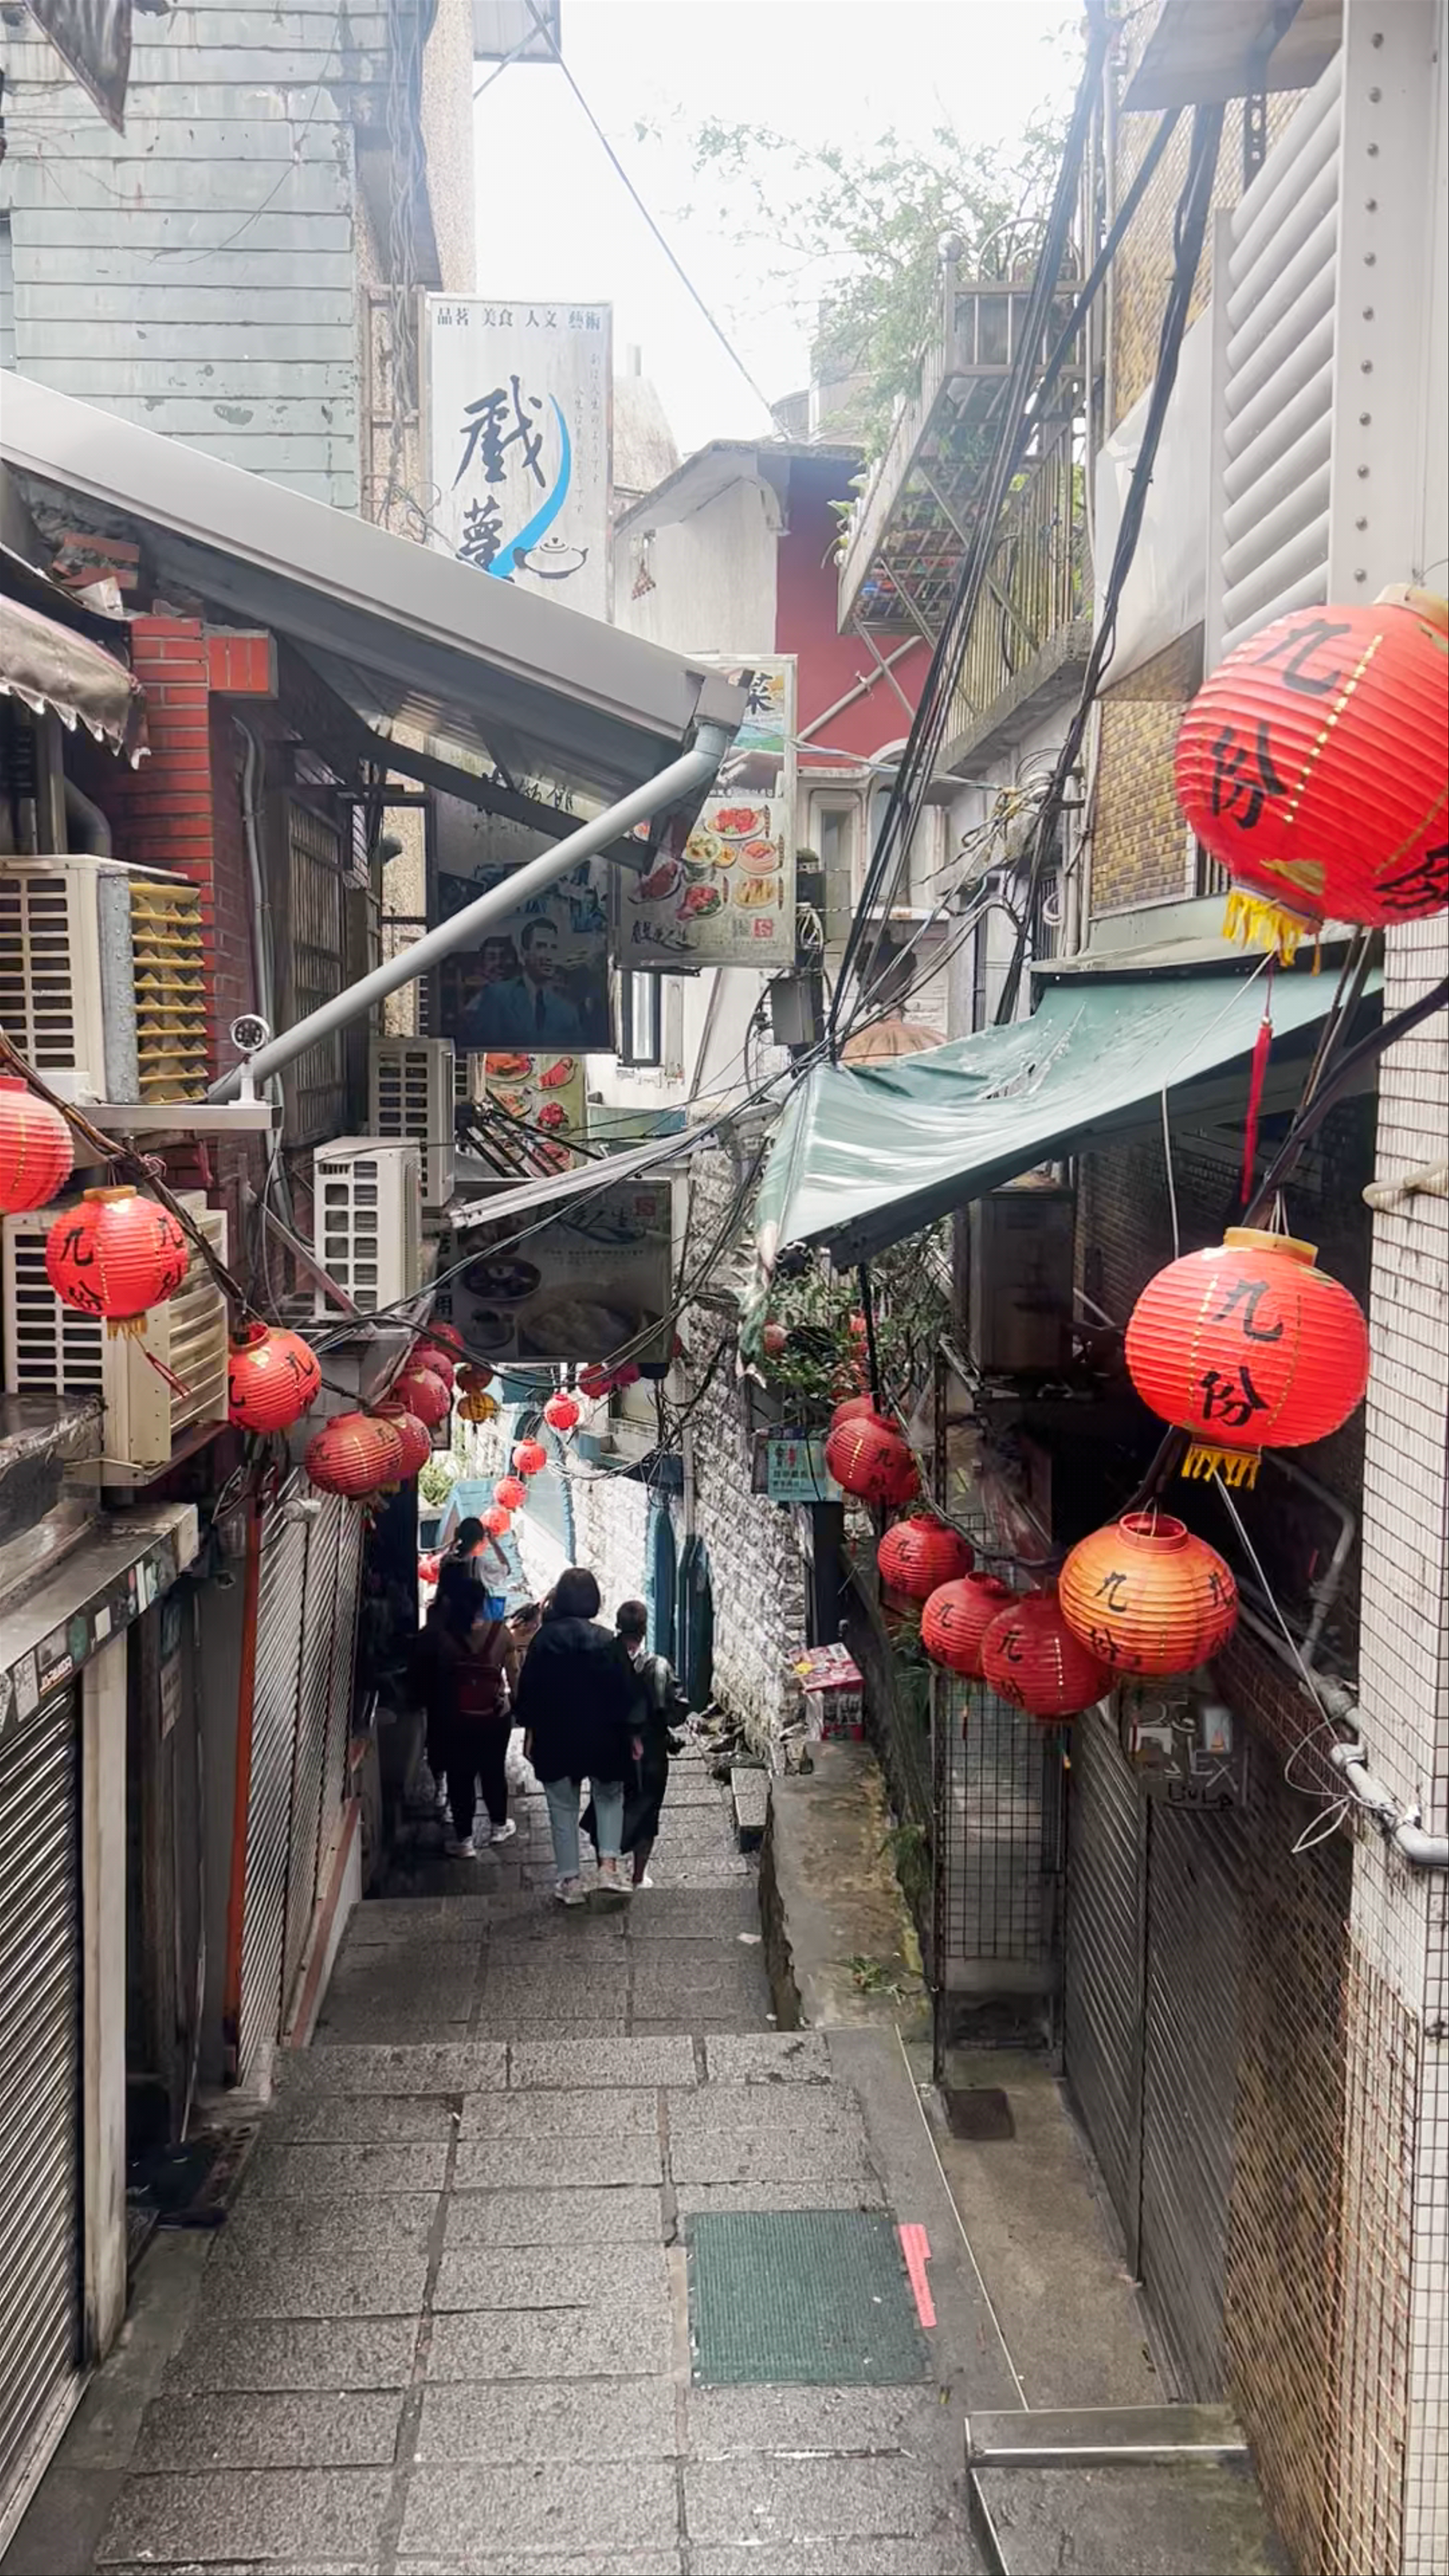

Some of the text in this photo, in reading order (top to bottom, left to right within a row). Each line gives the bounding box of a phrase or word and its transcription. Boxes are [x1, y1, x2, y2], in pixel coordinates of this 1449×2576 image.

[437, 307, 600, 330] 品茗 美食 人文 藝術
[1210, 619, 1352, 830] 九份
[60, 1226, 106, 1311] 九份
[1199, 1278, 1284, 1426] 九份
[1088, 1570, 1128, 1662] 九份
